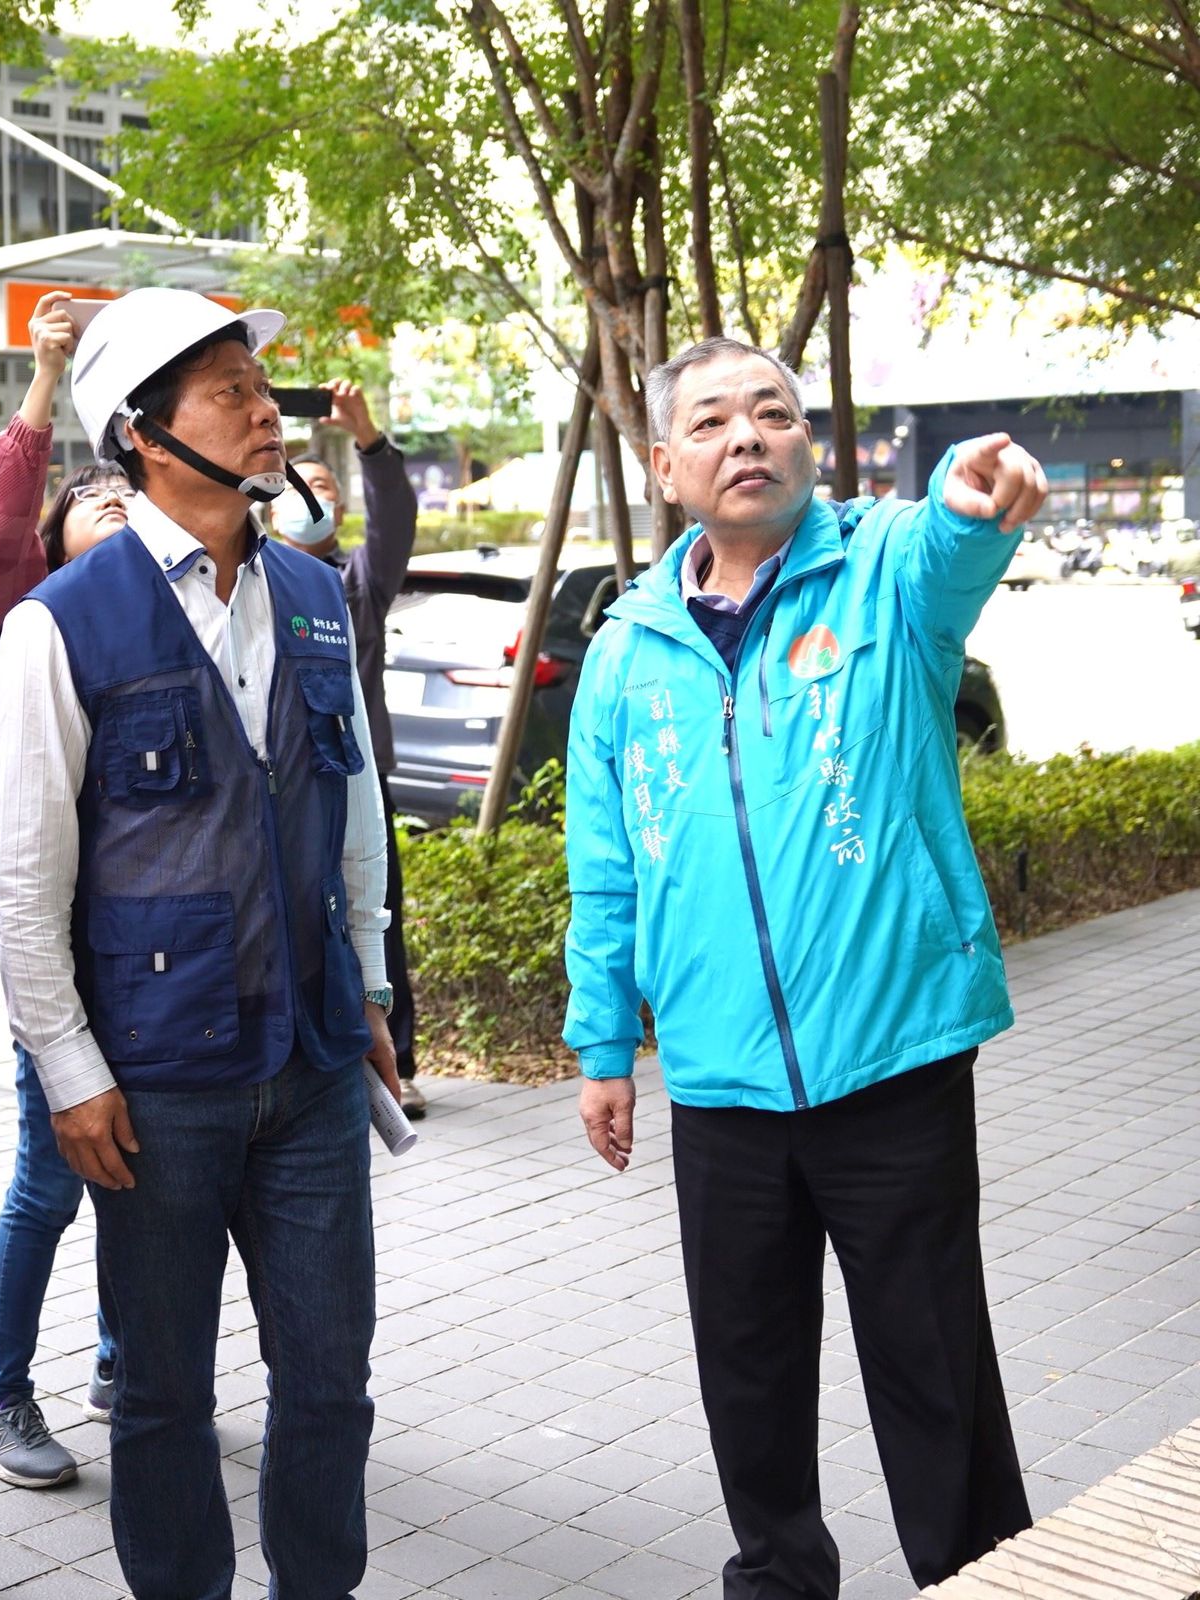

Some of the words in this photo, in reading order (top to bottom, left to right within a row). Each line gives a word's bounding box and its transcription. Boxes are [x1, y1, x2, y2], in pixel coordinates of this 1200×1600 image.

[313, 617, 341, 631] 新竹瓦斯
[650, 689, 688, 793] 副縣長
[807, 683, 865, 865] 新竹縣政府
[624, 740, 669, 865] 陳見賢
